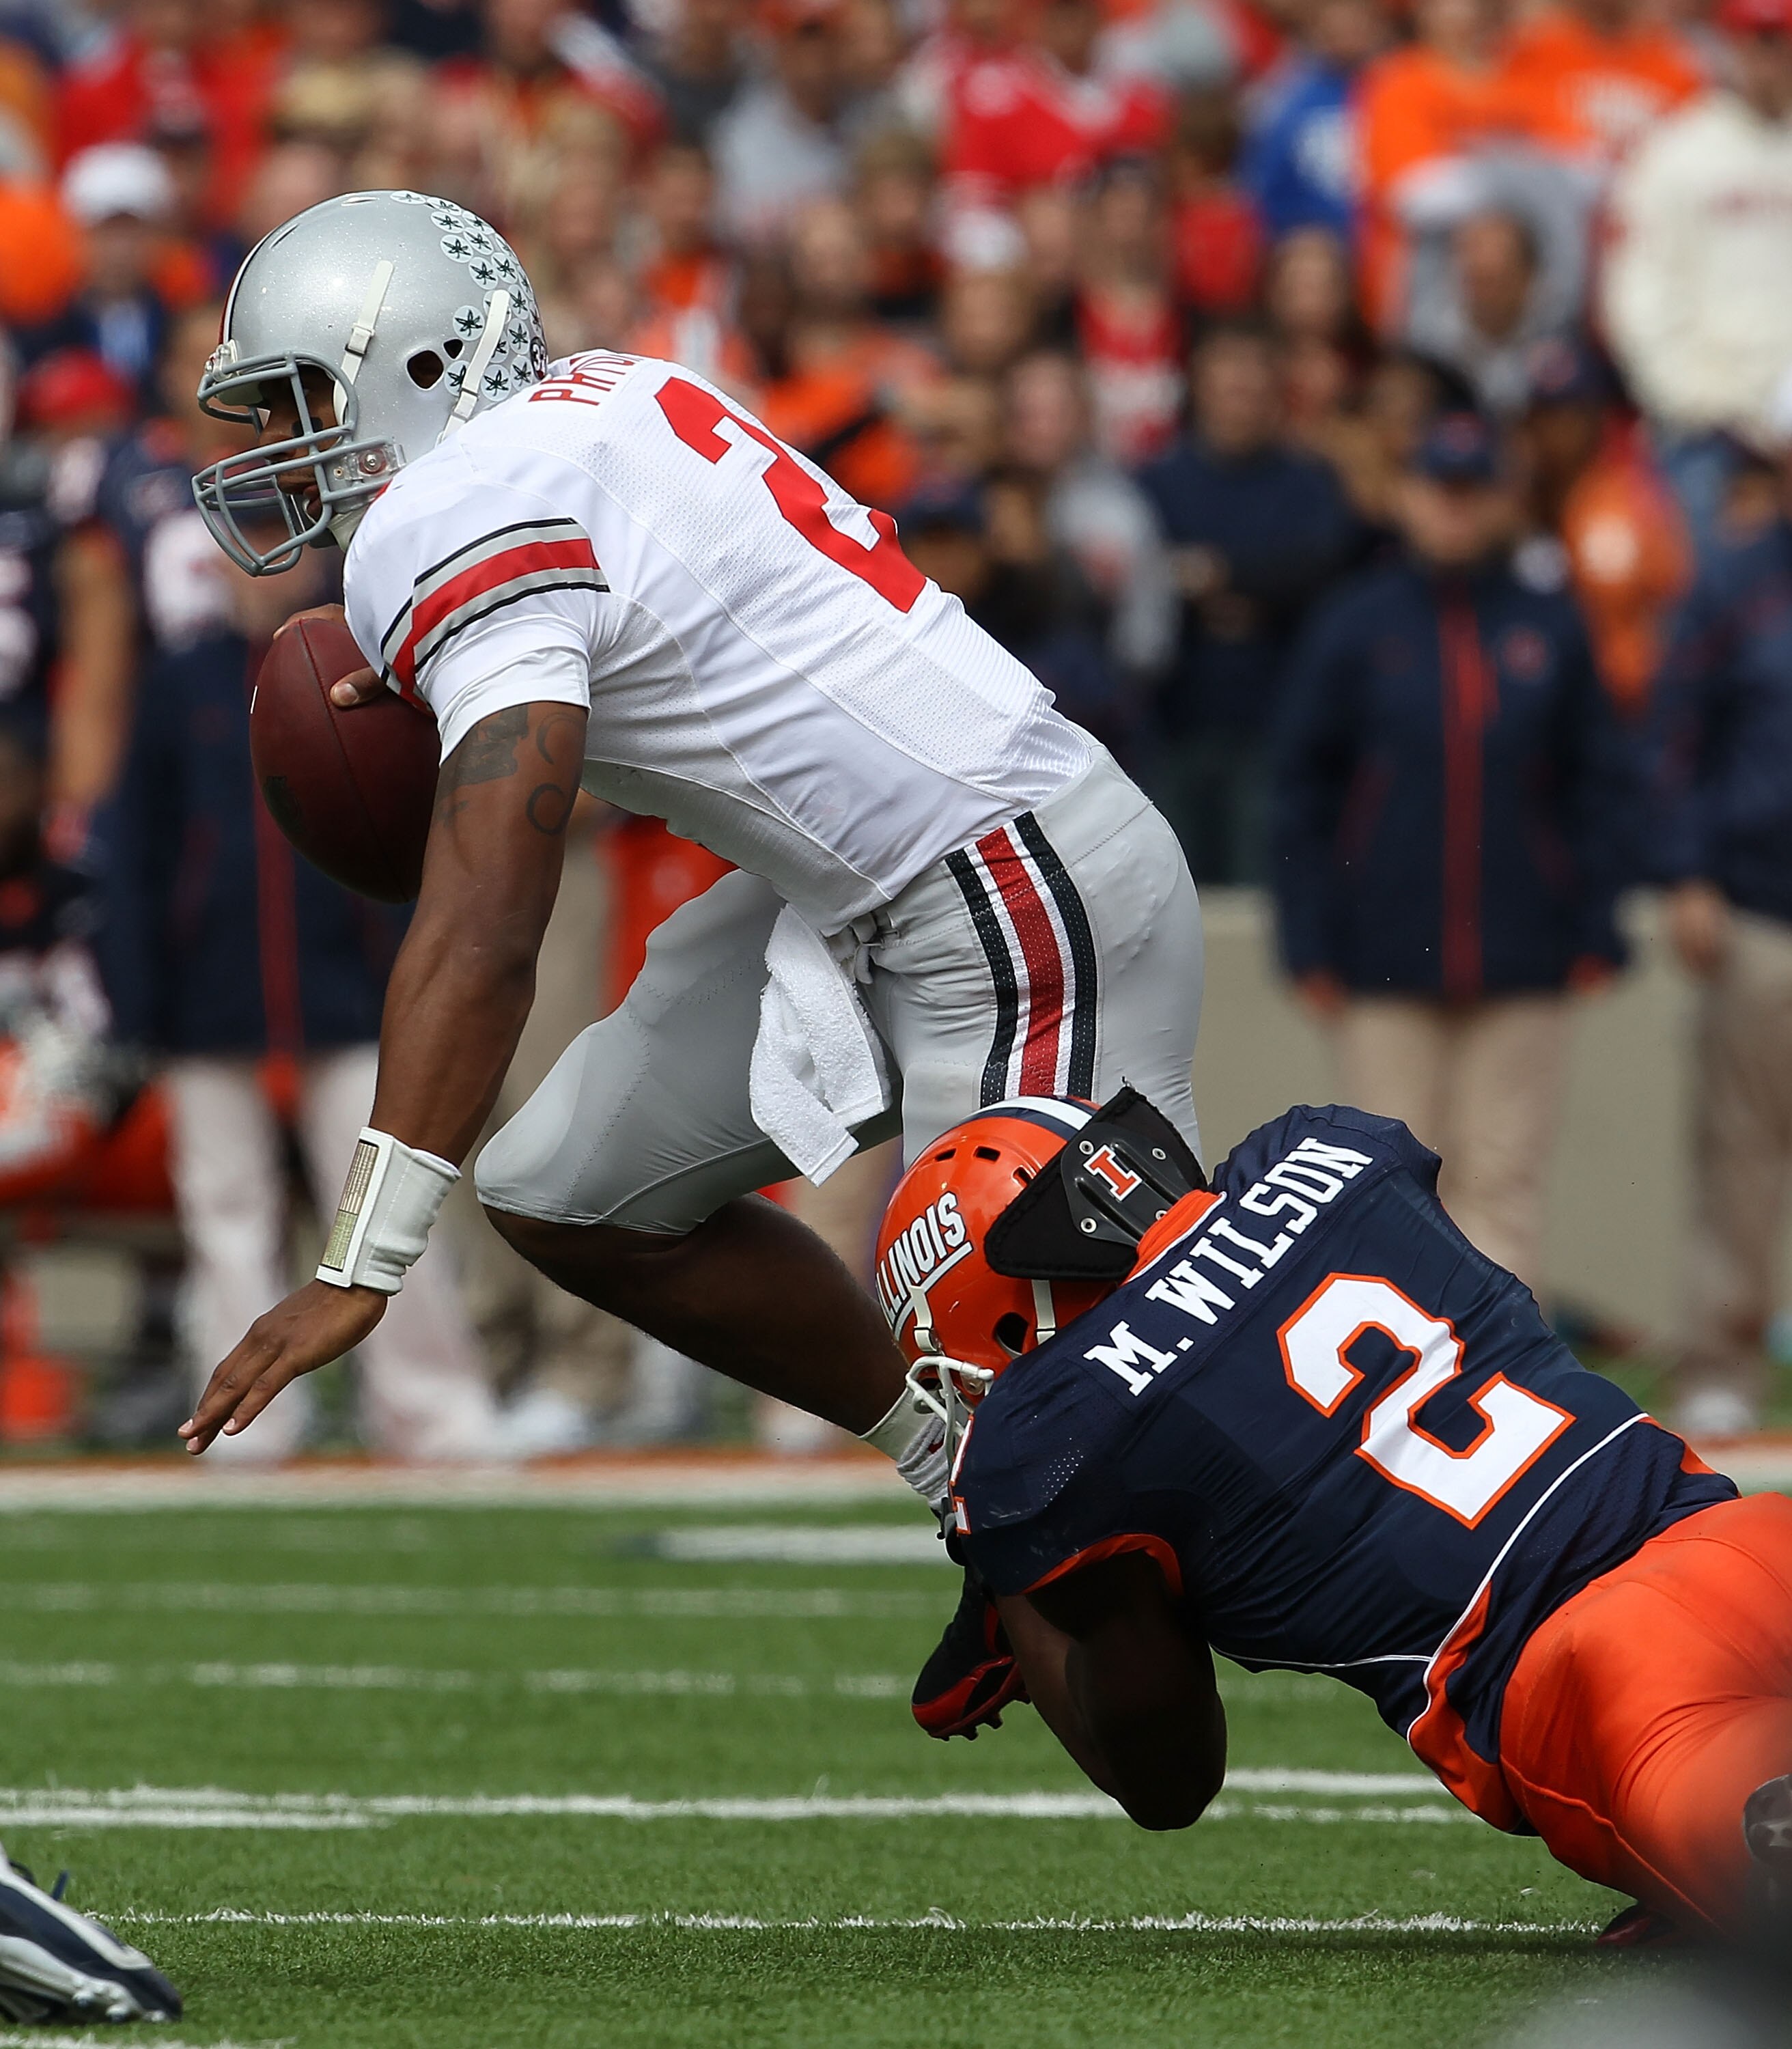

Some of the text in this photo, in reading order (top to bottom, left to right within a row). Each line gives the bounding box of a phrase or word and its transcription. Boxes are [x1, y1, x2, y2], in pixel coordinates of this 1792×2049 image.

[654, 376, 927, 614] 2
[1083, 1145, 1142, 1201] I
[1145, 1138, 1373, 1325] WILSON
[1276, 1272, 1576, 1530] 2
